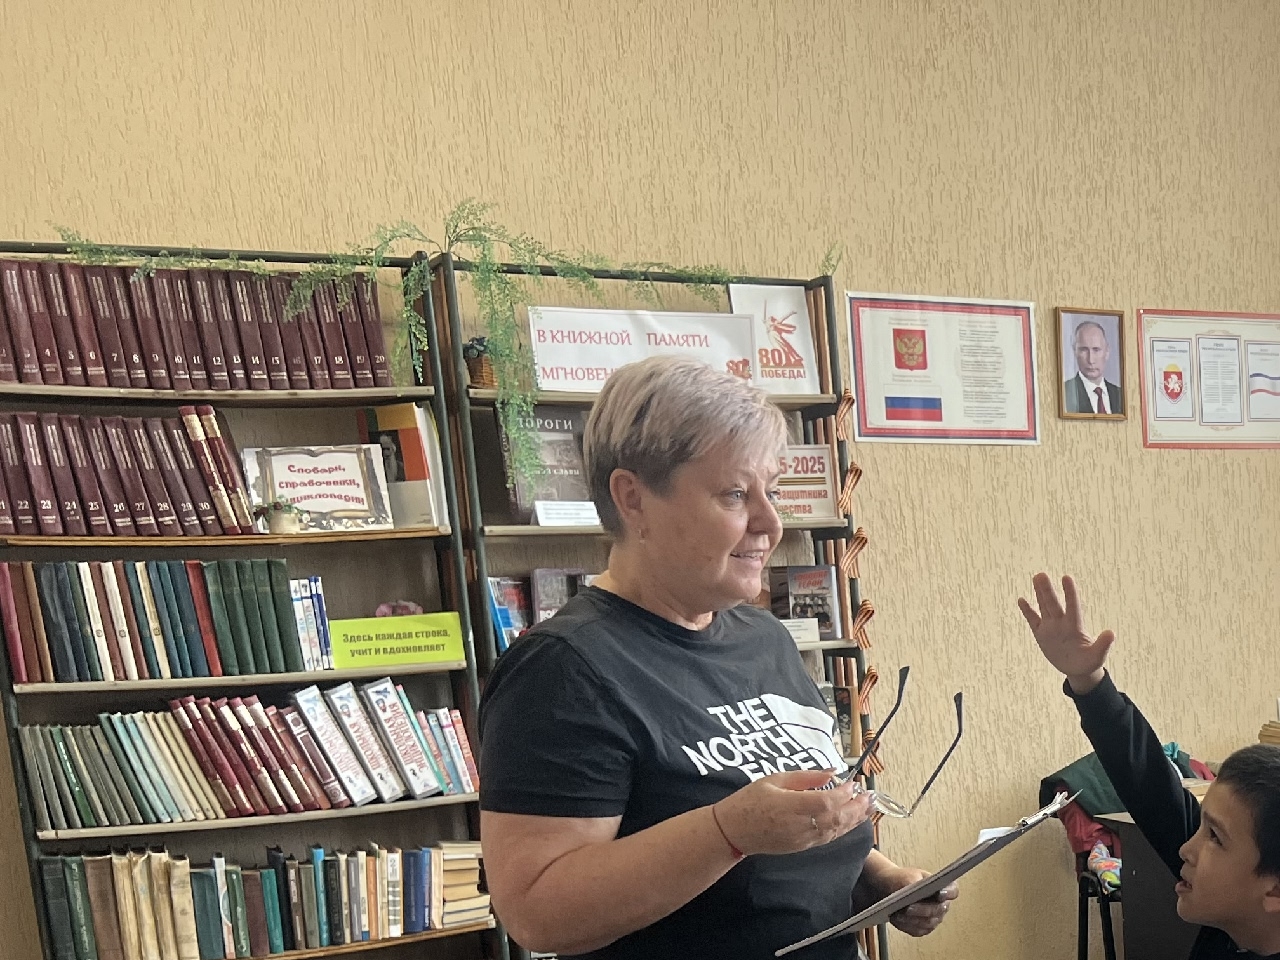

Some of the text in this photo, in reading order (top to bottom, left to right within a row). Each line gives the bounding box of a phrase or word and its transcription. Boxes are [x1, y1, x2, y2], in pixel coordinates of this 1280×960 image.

[536, 329, 711, 348] В КНИЖНОЙ ПАМЯТИ
[111, 353, 118, 362] 7
[541, 366, 616, 381] МГНОВЕН
[760, 369, 806, 380] ПОБЕДА!
[778, 455, 826, 475] 5-2025
[17, 500, 30, 510] 22
[285, 493, 365, 506] нциклопедии
[342, 633, 374, 643] Здесь
[375, 631, 414, 641] каждая
[350, 643, 446, 657] учит и вдохновляет
[707, 698, 777, 734] THE
[383, 716, 414, 766] ШКОЛЬНАЯ
[388, 701, 428, 772] ЭНЦИКЛОПЕДИЯ
[681, 724, 806, 776] NORTH
